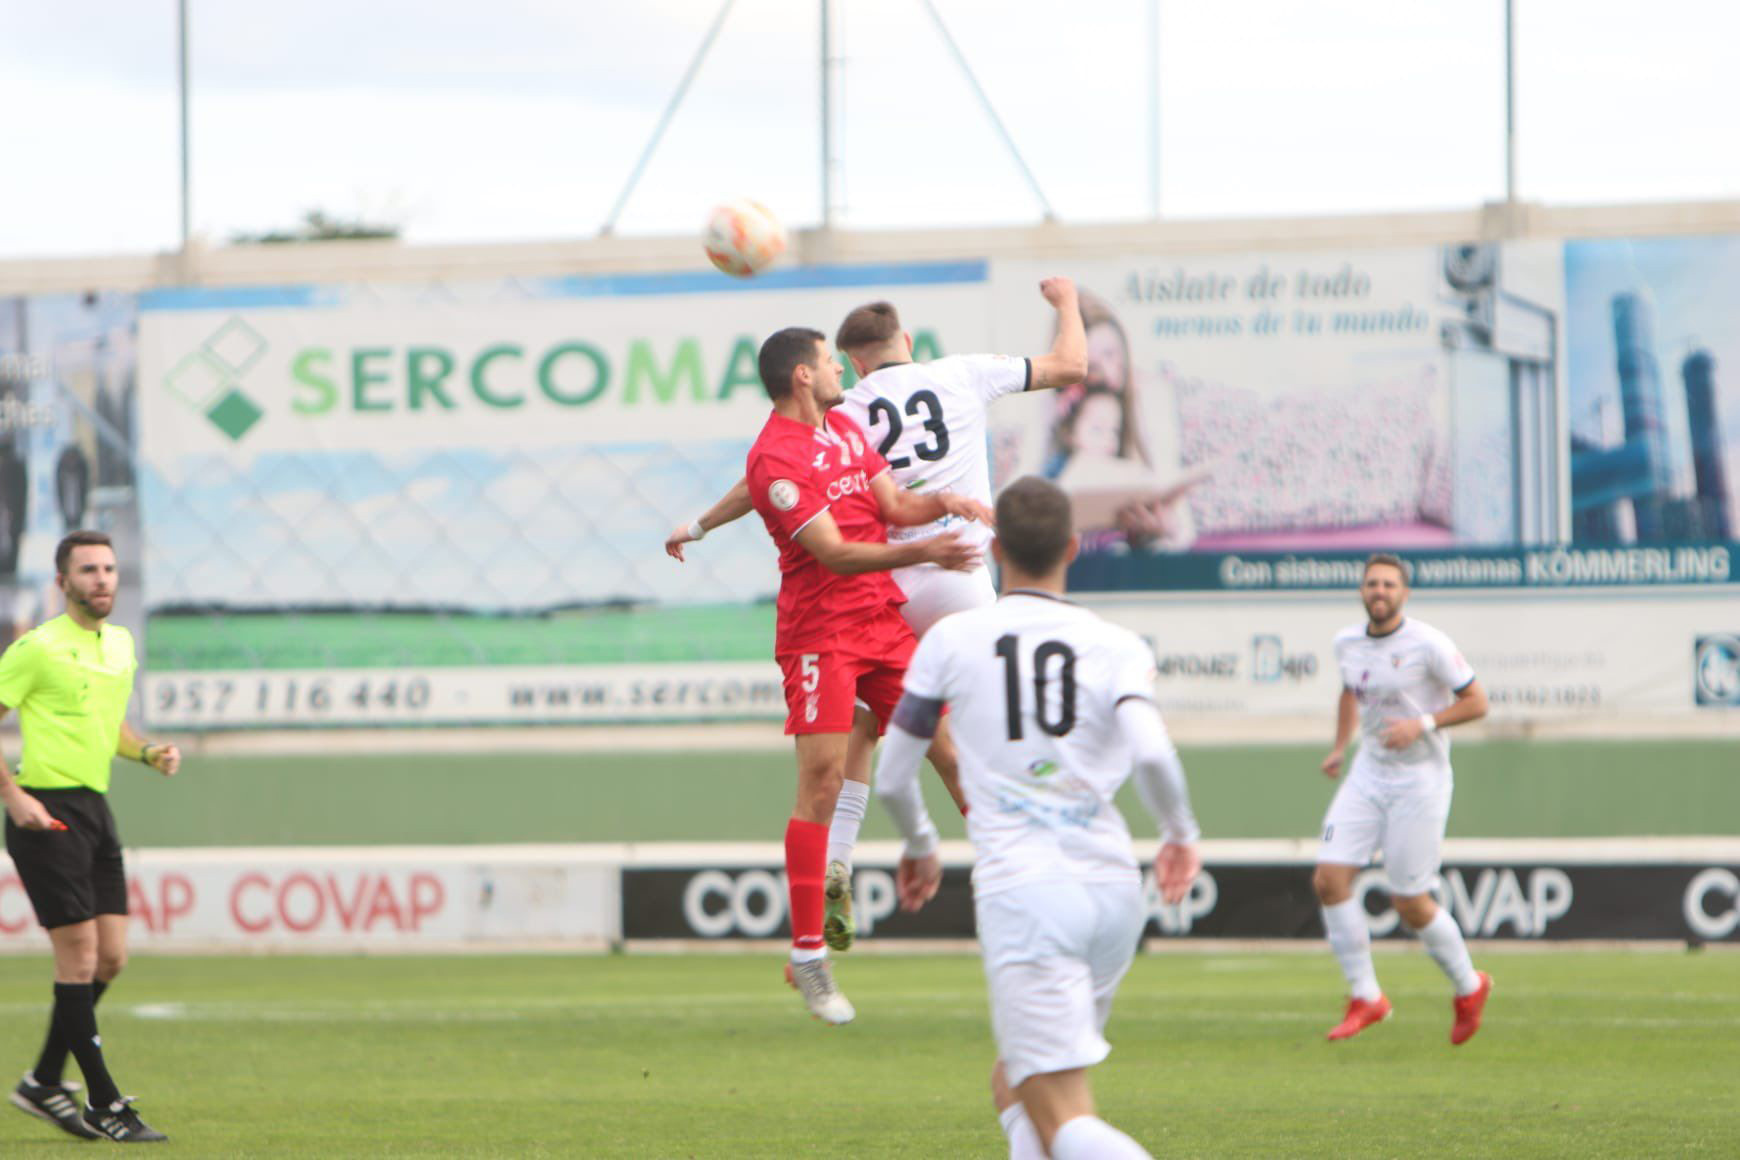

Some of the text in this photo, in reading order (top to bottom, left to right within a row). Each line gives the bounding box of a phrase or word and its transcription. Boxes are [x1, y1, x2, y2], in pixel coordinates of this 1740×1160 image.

[1296, 261, 1371, 298] todo
[1153, 313, 1242, 337] menos
[1331, 302, 1430, 333] mundo
[868, 389, 950, 470] 23
[1220, 556, 1271, 585] Con
[1417, 557, 1522, 584] ventanas
[256, 678, 333, 711] 116
[351, 676, 431, 710] 440
[508, 679, 788, 706] www.sercom
[801, 653, 820, 692] 5
[995, 634, 1076, 739] 10
[0, 872, 196, 934] CAP
[229, 872, 445, 934] COVAP
[684, 869, 897, 937] COP
[1351, 868, 1573, 936] CVAP
